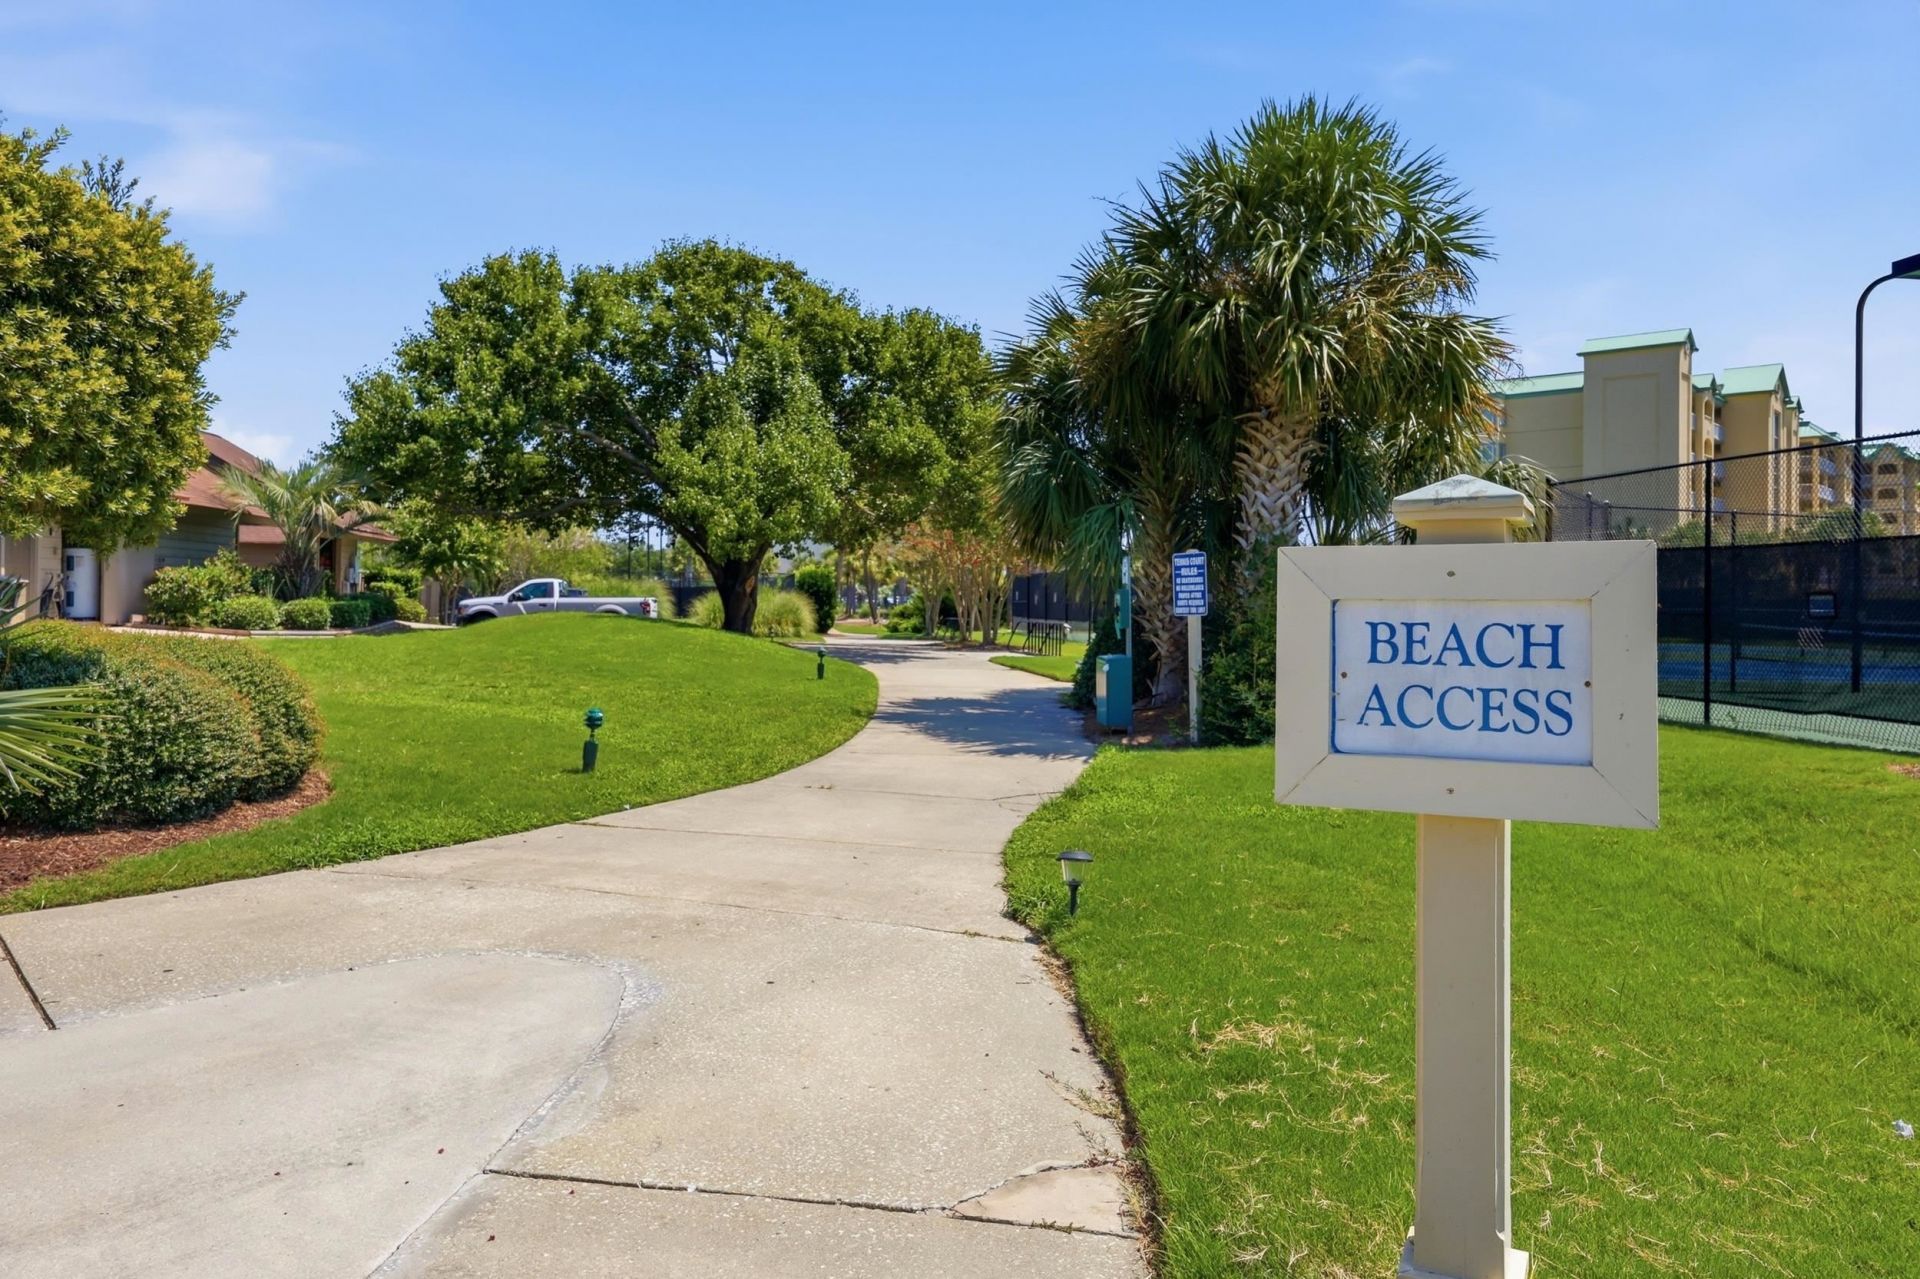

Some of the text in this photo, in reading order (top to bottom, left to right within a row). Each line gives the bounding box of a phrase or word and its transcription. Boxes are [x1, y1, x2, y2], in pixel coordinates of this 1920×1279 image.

[1181, 567, 1197, 576] RULES
[1190, 557, 1204, 565] COURT
[1366, 621, 1565, 671] BEACH
[1357, 684, 1573, 737] ACCESS
